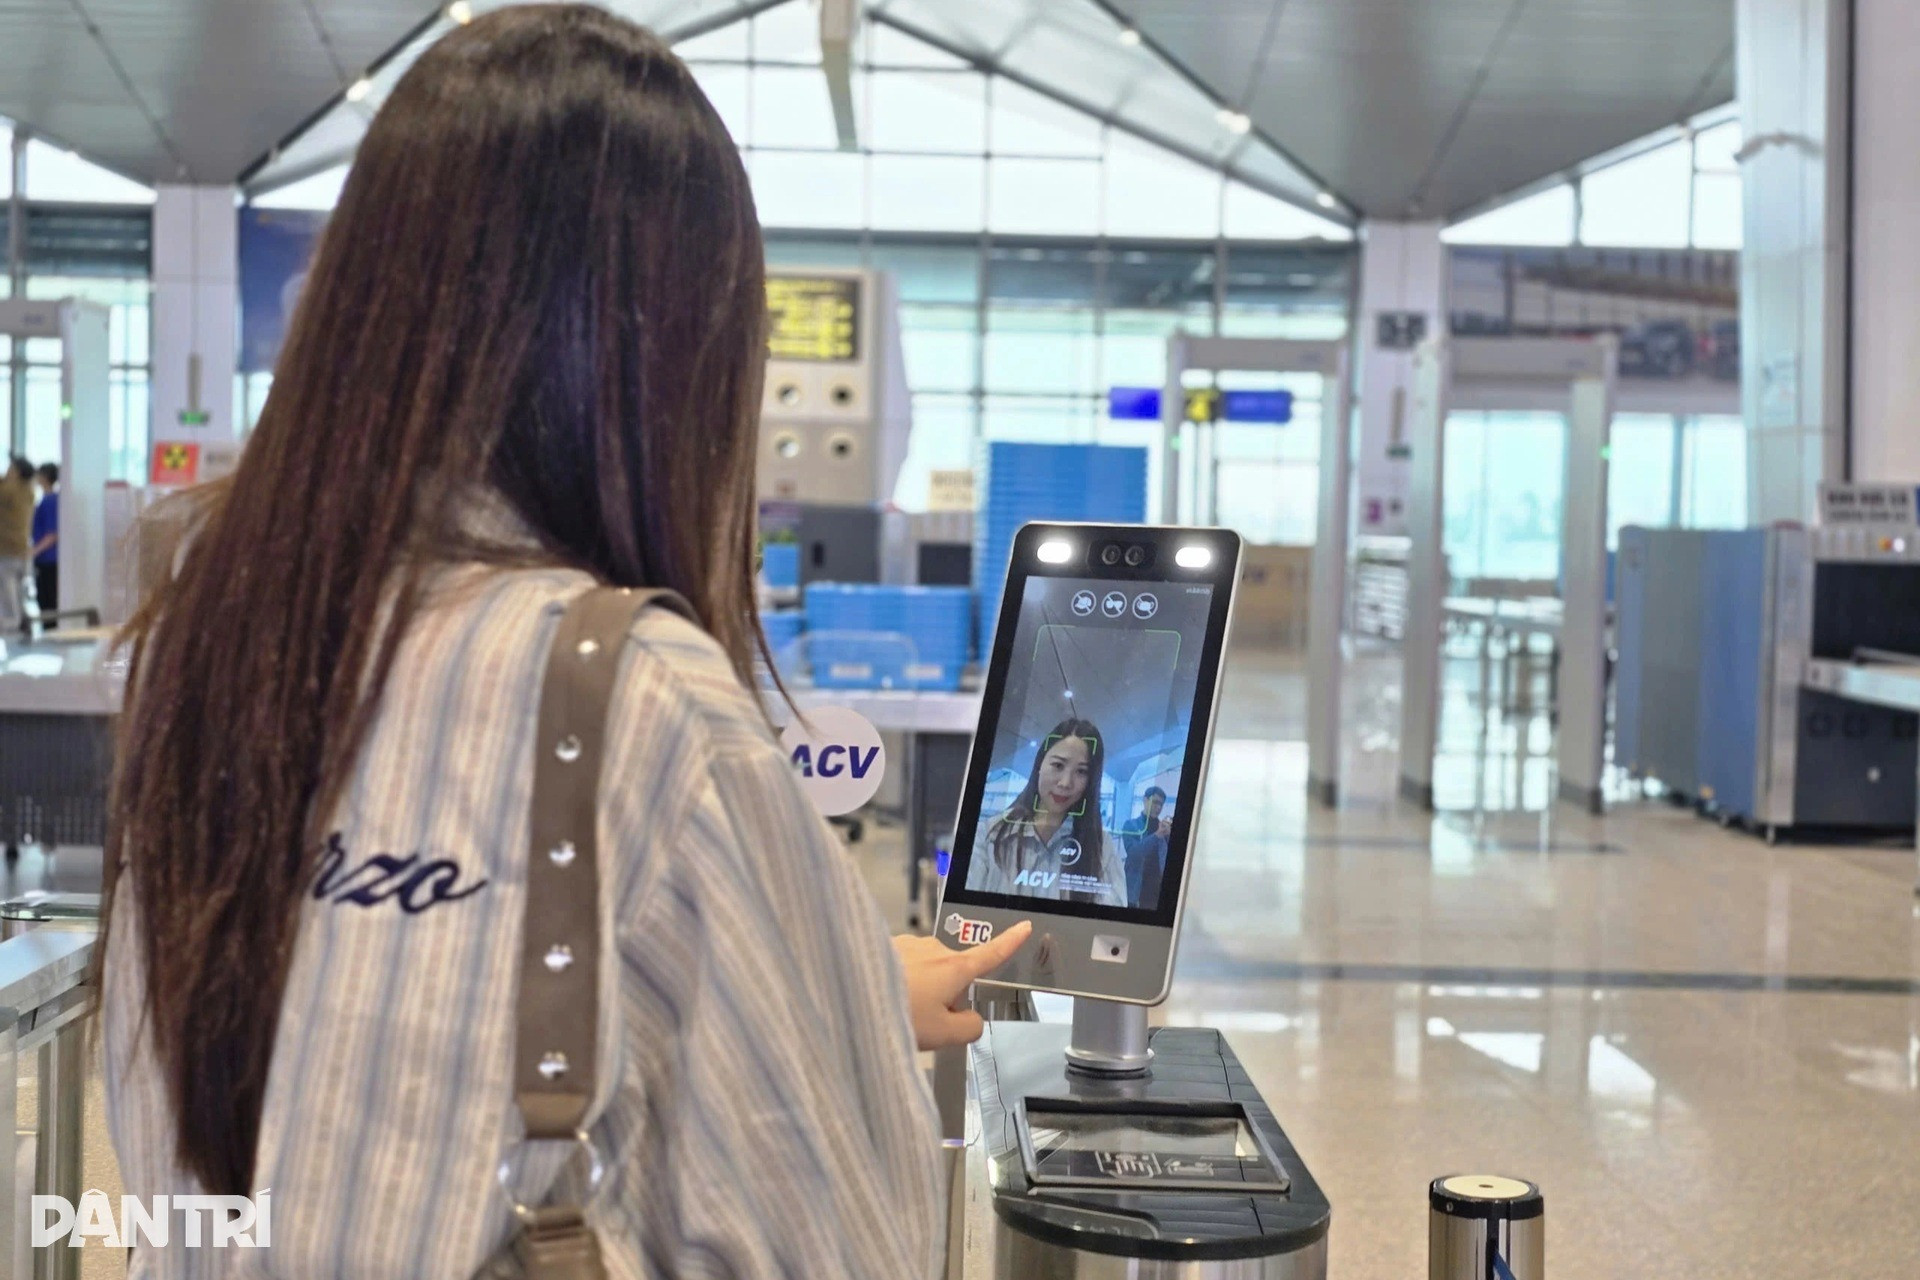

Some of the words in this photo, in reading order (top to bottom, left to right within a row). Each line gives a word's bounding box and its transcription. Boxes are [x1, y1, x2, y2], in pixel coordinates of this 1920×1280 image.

[790, 743, 881, 779] ACV
[1013, 869, 1058, 889] ACV
[961, 922, 990, 943] ETC
